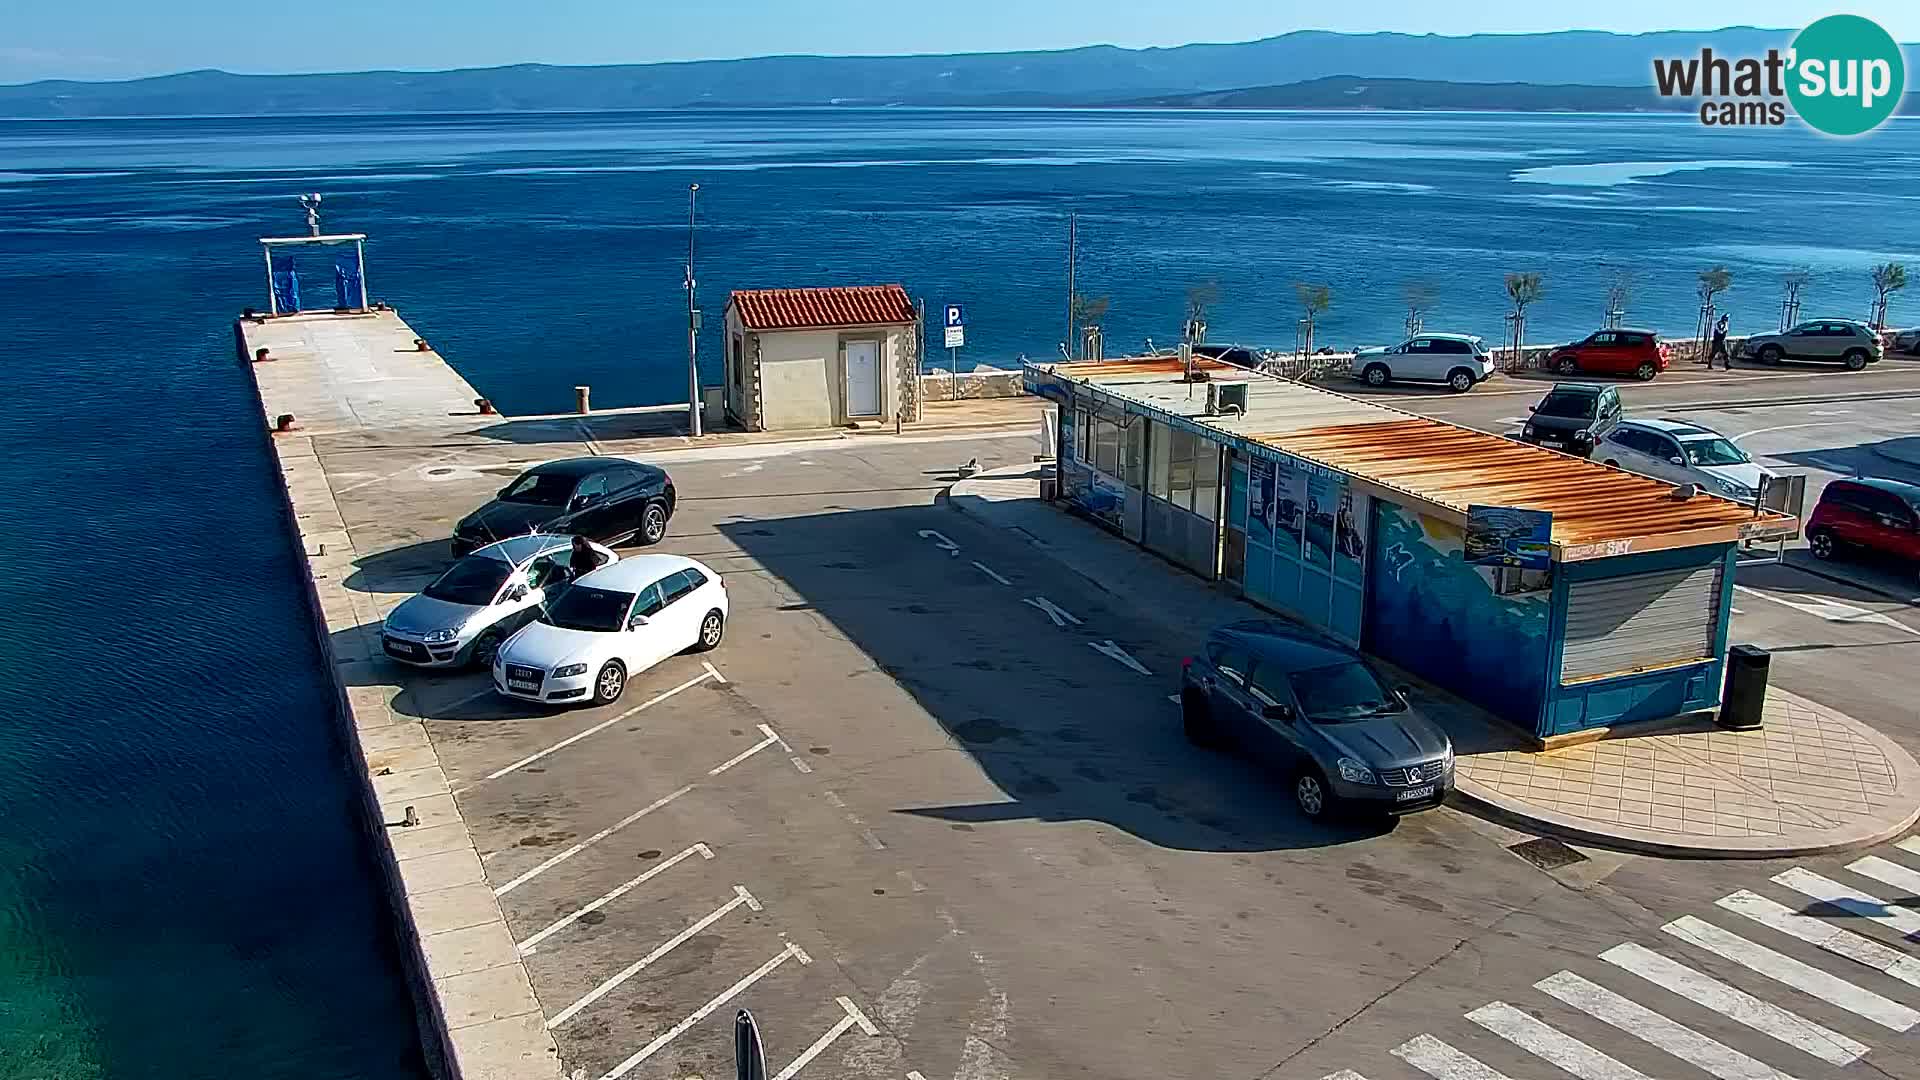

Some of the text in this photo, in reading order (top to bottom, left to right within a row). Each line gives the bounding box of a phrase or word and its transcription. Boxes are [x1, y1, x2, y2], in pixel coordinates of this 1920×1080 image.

[948, 307, 960, 325] P
[1261, 448, 1291, 465] STATION
[1293, 459, 1318, 474] TICKET
[1318, 467, 1345, 483] OFFICE
